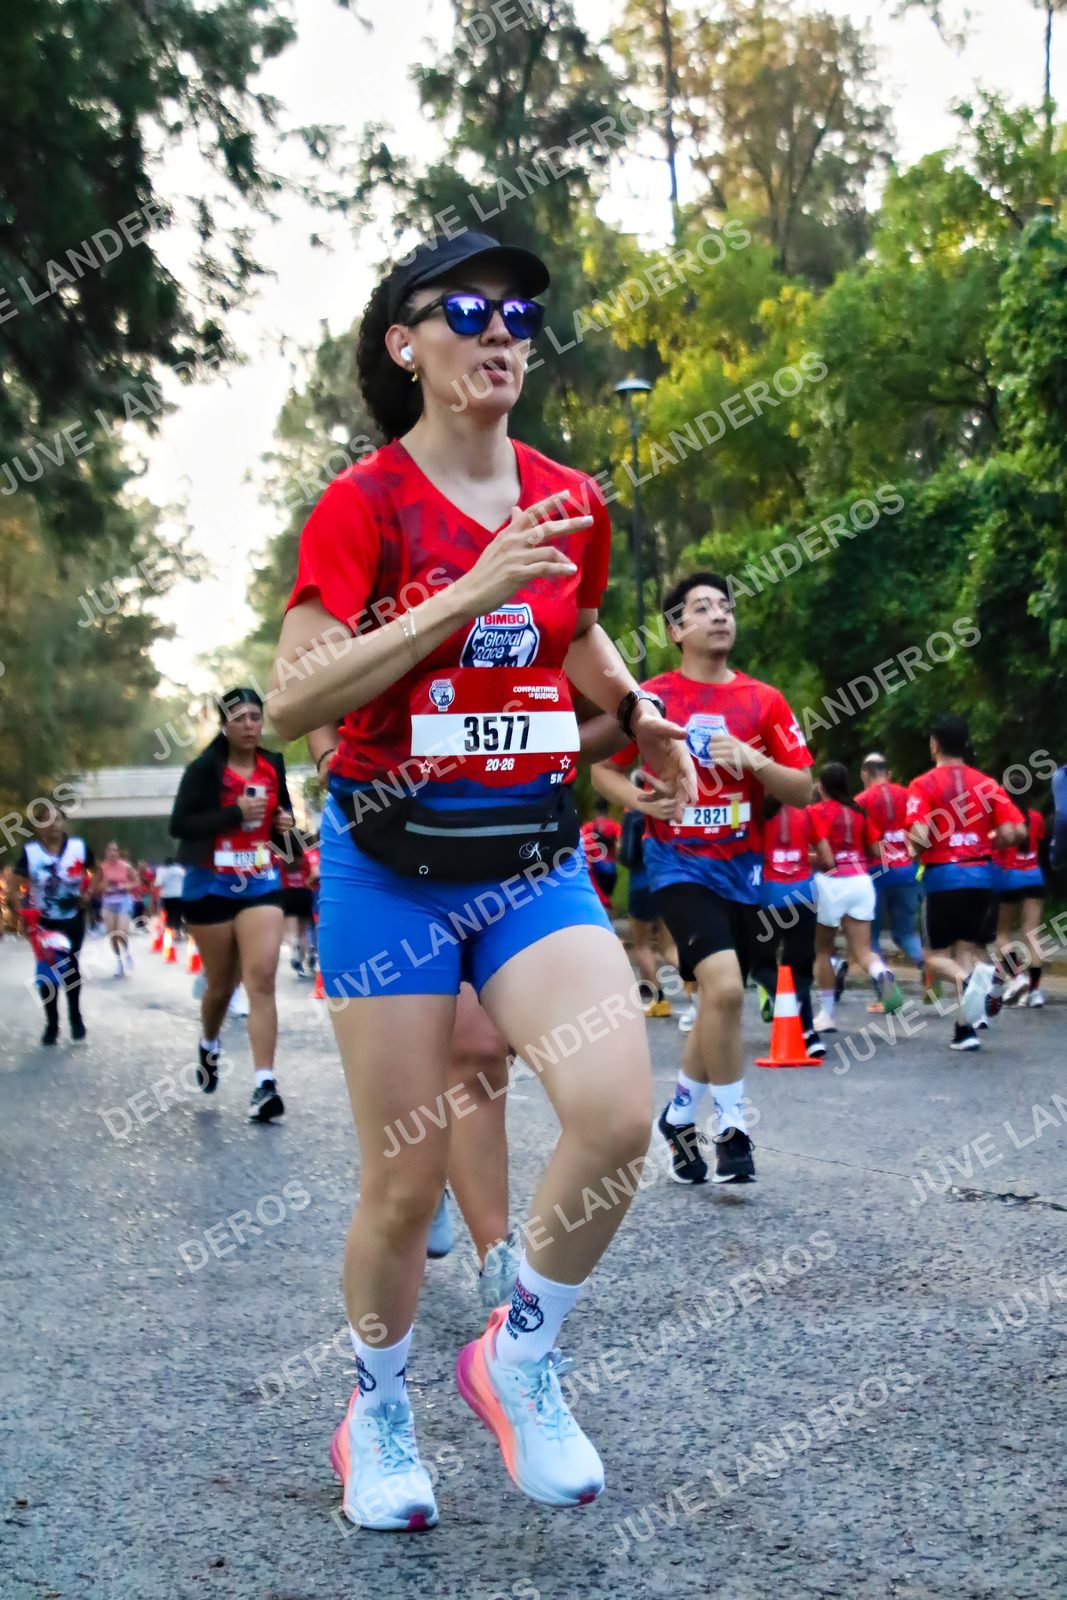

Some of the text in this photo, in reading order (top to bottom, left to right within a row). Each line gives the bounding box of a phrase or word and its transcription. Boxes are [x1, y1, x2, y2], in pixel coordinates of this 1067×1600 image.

[484, 614, 525, 625] BIMBO
[484, 630, 524, 647] Global
[472, 646, 505, 660] Race
[463, 715, 530, 752] 3577
[694, 807, 728, 825] 2821
